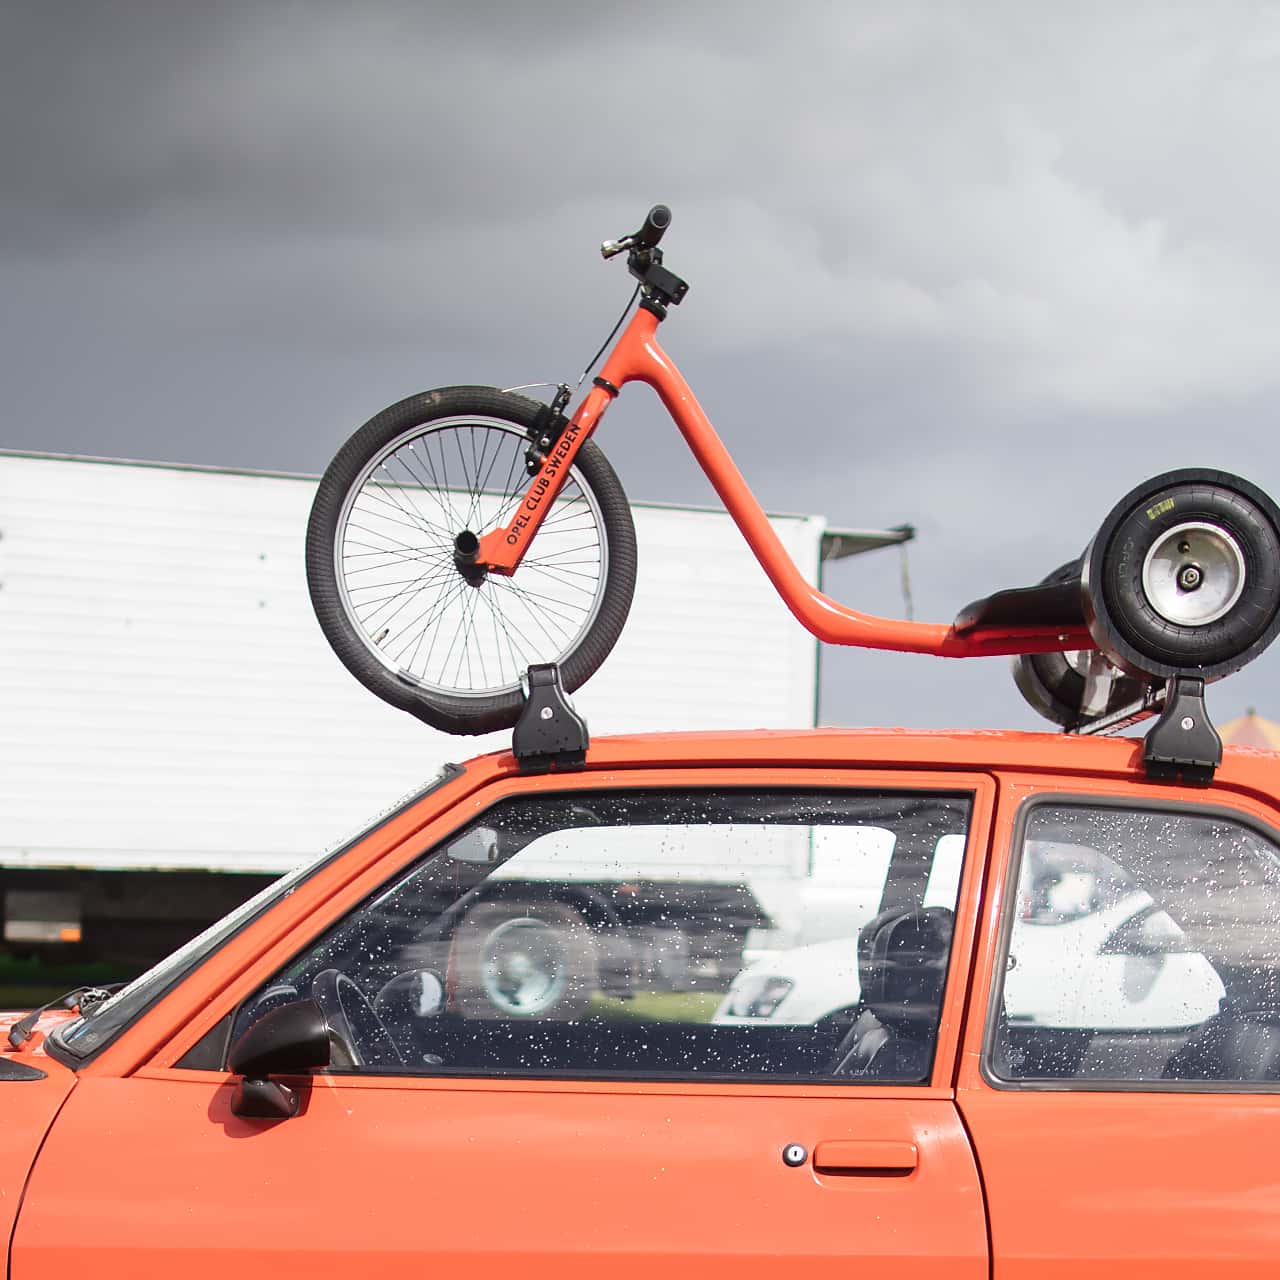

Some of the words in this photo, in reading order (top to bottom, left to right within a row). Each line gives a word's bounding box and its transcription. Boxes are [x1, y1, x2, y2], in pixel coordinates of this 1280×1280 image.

[506, 513, 531, 546] OPEL
[526, 477, 551, 511] CLUB
[545, 423, 582, 477] SWEDEN
